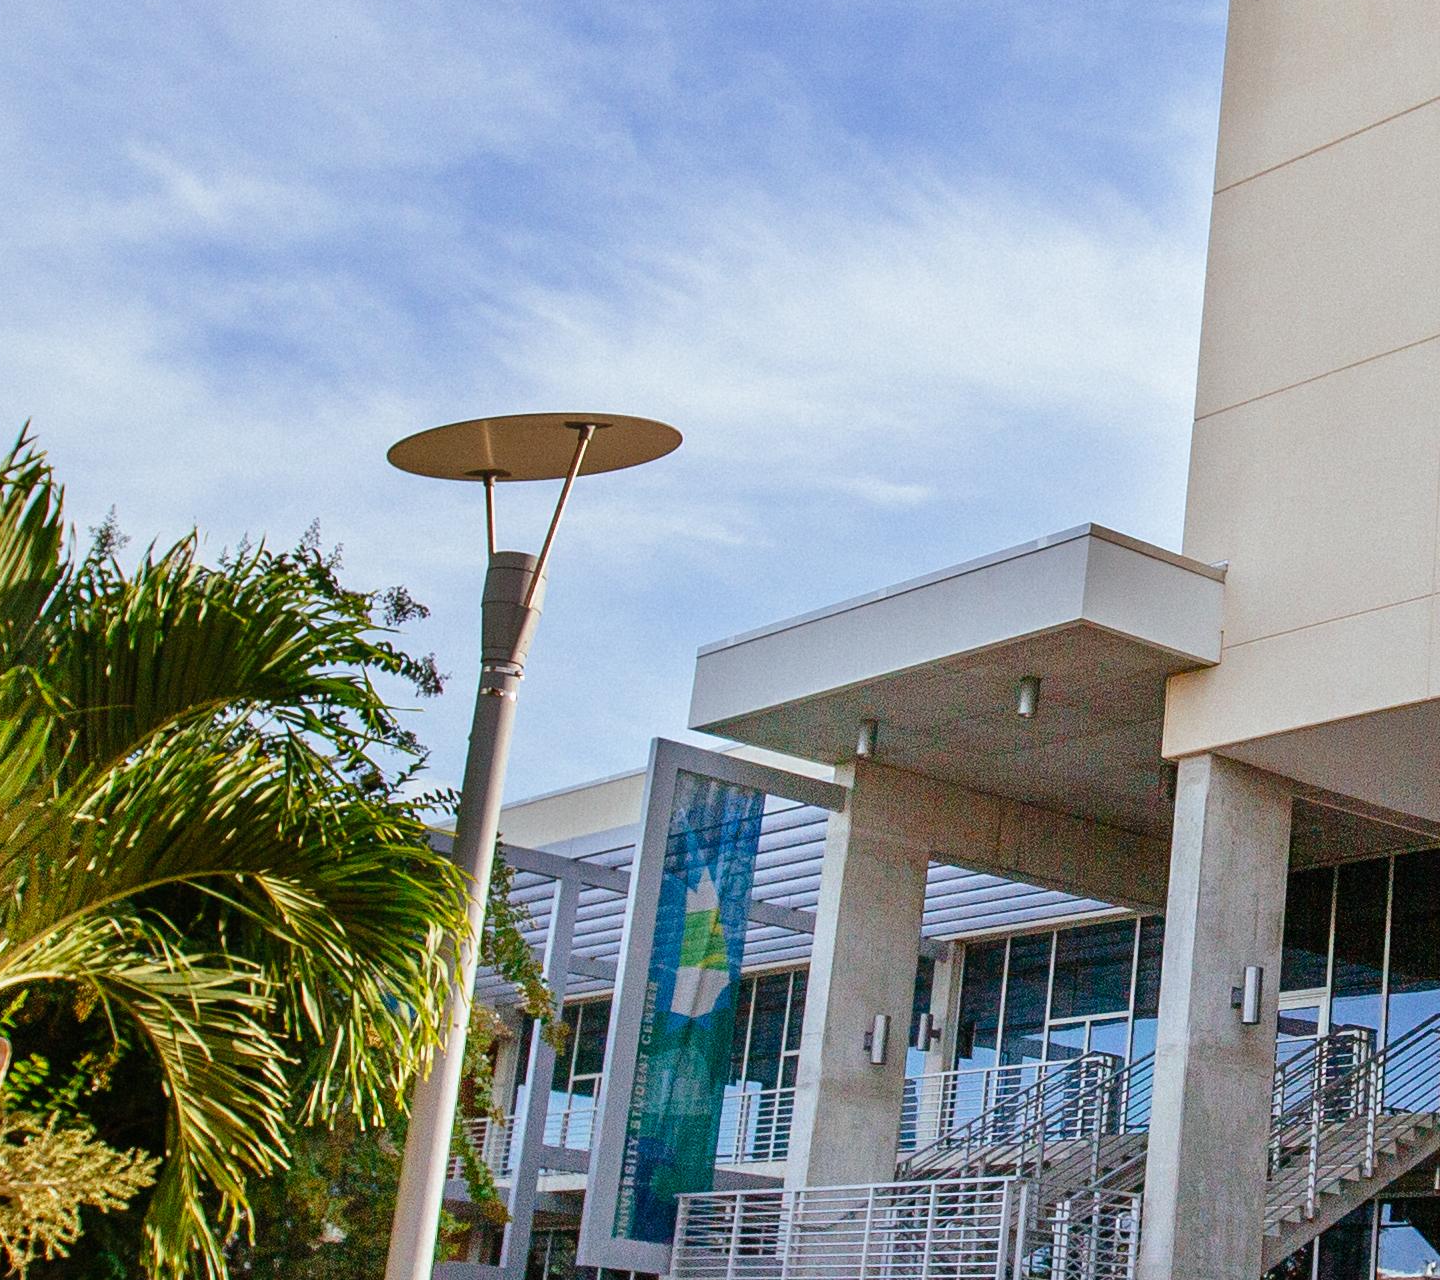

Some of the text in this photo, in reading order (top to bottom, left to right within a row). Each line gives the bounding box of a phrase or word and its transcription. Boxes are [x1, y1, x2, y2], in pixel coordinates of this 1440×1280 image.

[618, 981, 658, 1237] UNIVERSITY STUDENT CENTER
